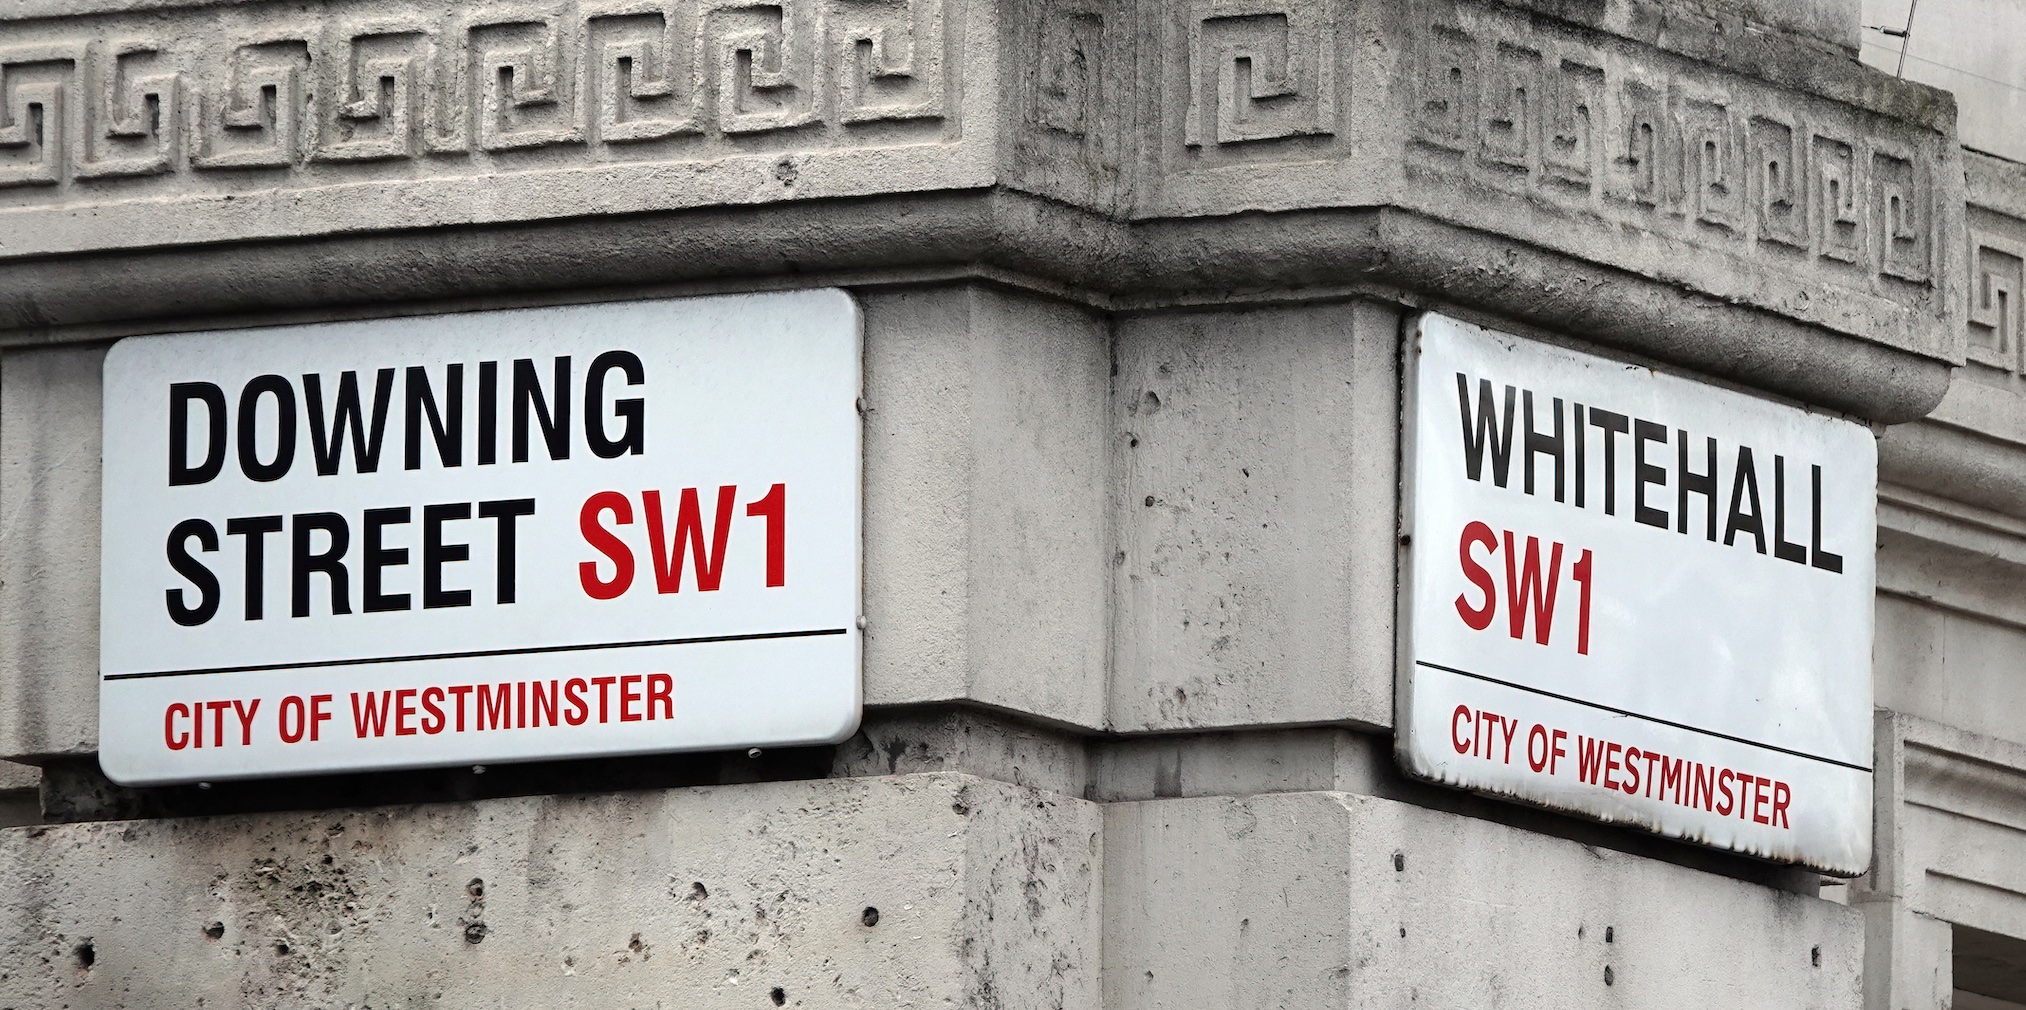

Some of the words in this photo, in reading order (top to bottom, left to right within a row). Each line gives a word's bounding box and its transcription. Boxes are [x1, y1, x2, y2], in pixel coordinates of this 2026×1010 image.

[168, 350, 645, 487] DOWNING
[1456, 372, 1843, 575] WHITEHALL
[165, 497, 536, 627] STREET
[578, 482, 786, 601] SW1
[1454, 520, 1593, 656] SW1
[164, 698, 261, 751] CITY
[278, 693, 333, 745] OF
[350, 673, 675, 739] WESTMINSTER
[1451, 704, 1518, 765] CITY
[1527, 723, 1568, 777] OF
[1577, 735, 1791, 830] WESTMINSTER
